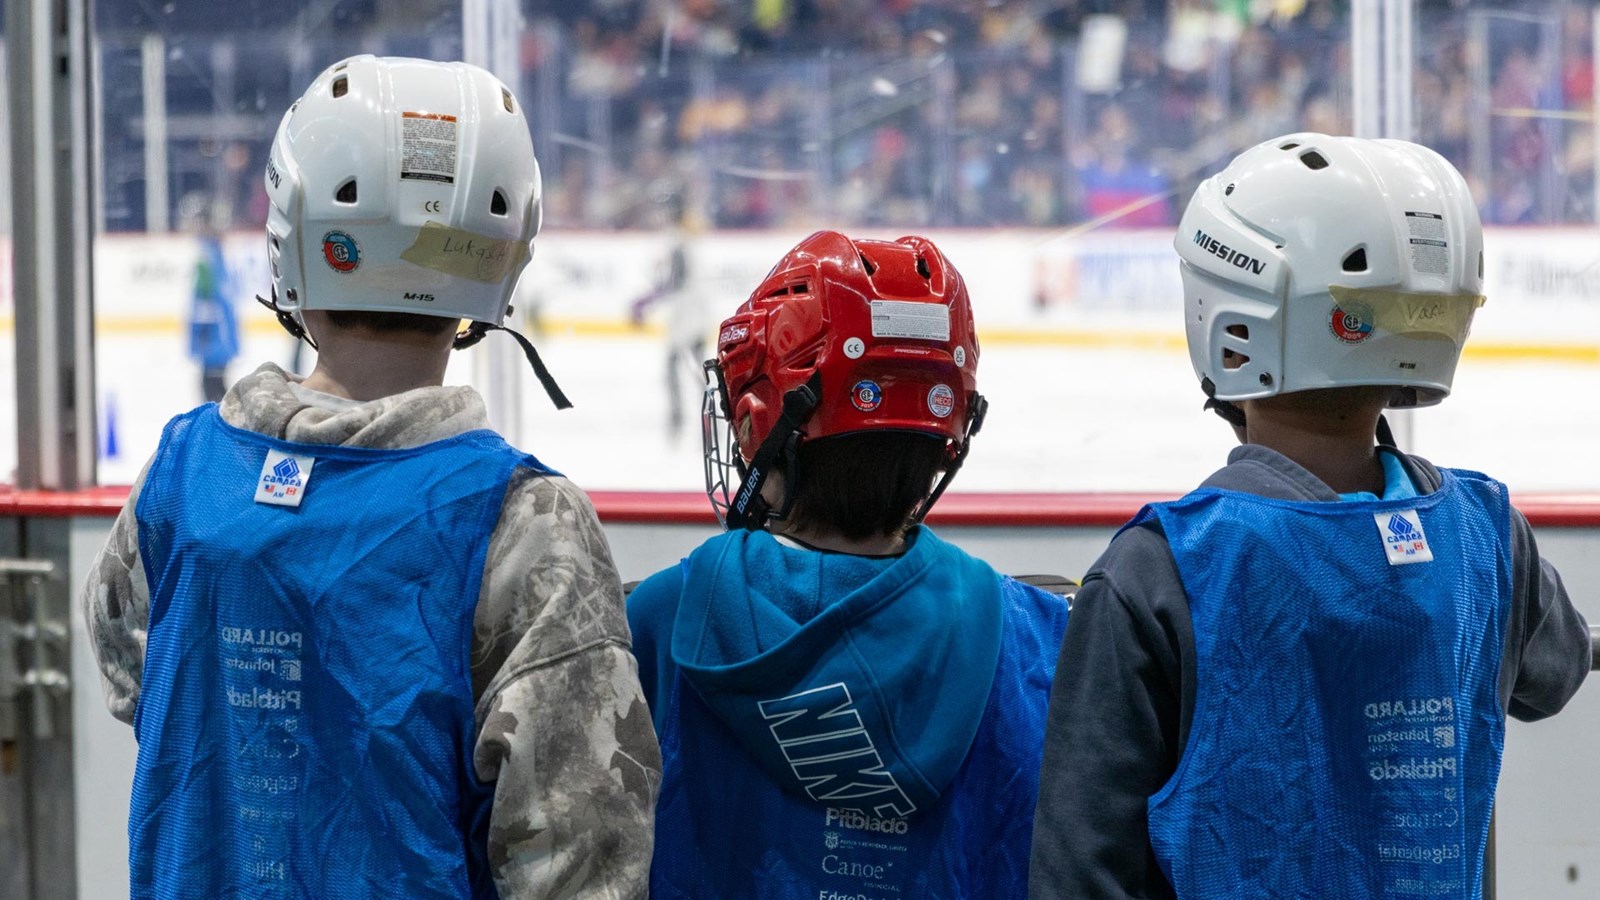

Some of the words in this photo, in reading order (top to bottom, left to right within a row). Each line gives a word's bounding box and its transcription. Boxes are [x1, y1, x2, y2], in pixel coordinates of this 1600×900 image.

[425, 201, 440, 212] CE
[1193, 229, 1267, 275] MISSION
[403, 292, 435, 302] M-15
[1342, 331, 1361, 340] 2009
[847, 343, 860, 353] CE
[736, 467, 760, 515] BAUER
[1405, 548, 1416, 556] AM
[757, 682, 917, 818] NIKE
[821, 854, 884, 880] Canoe
